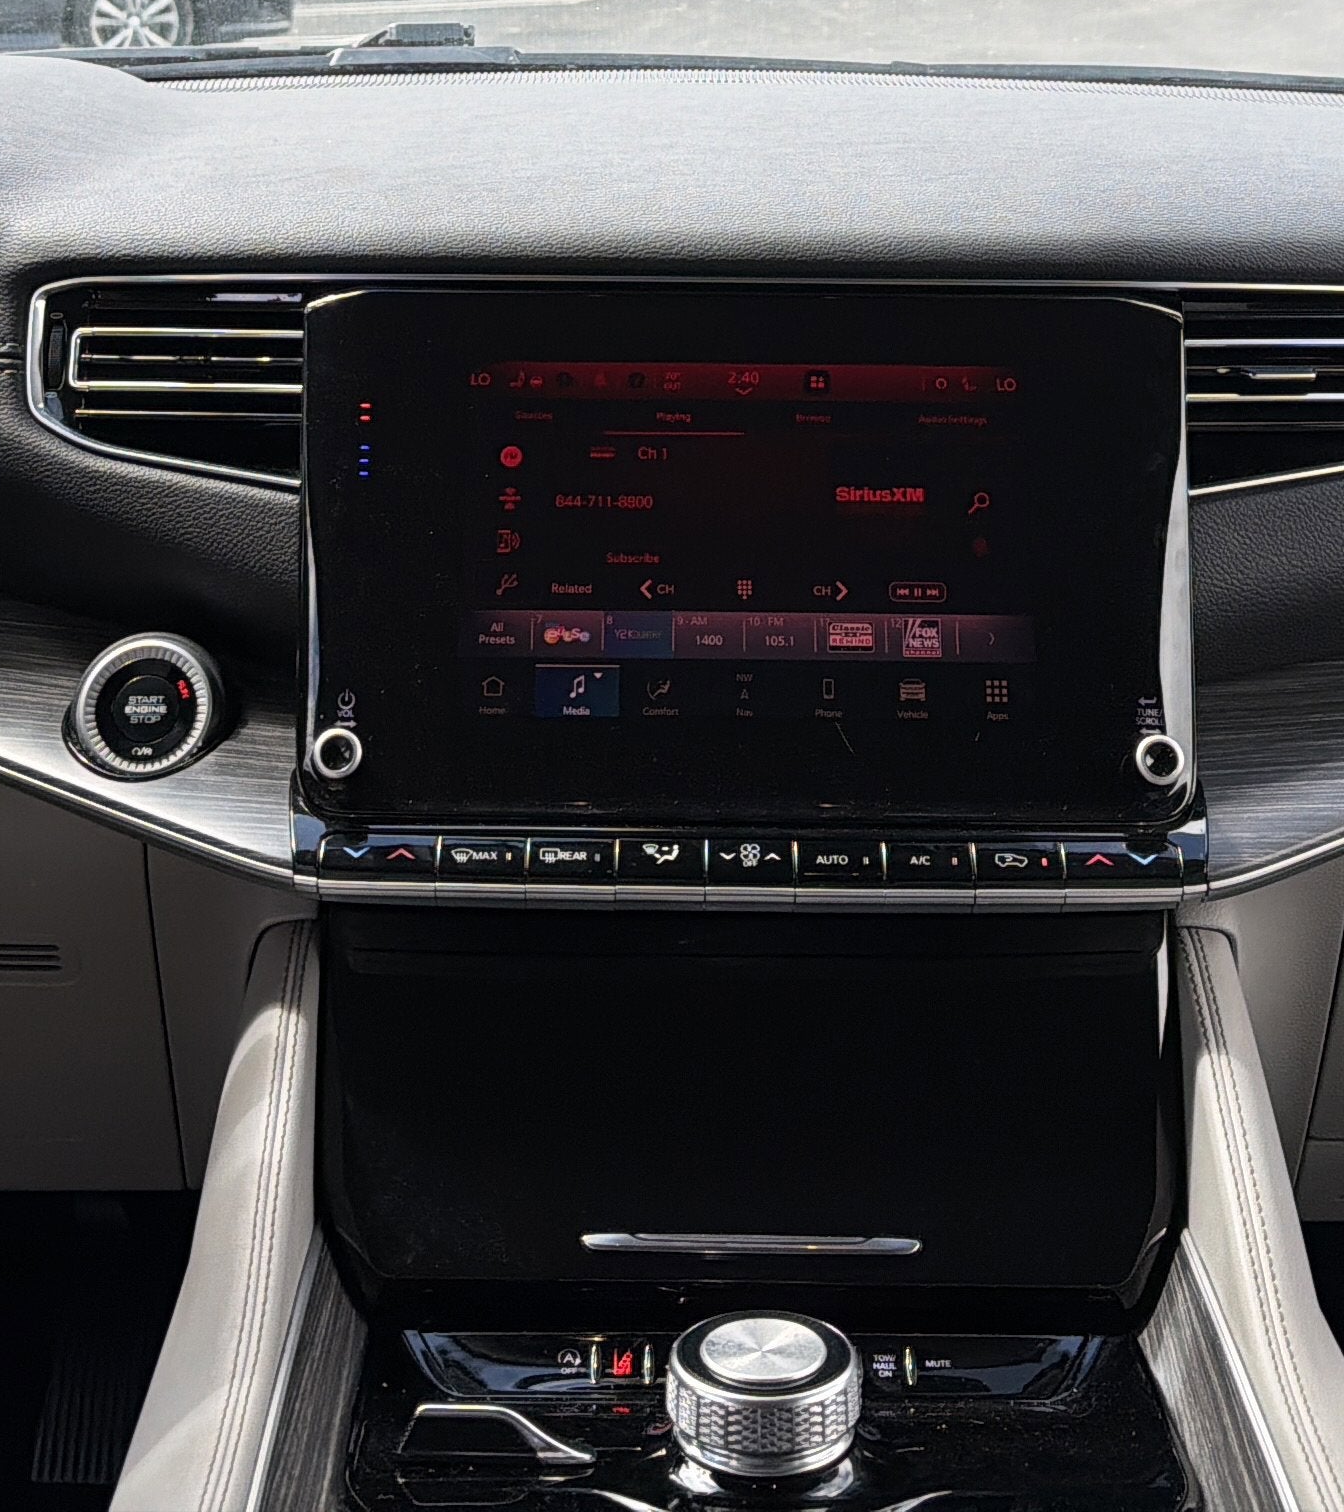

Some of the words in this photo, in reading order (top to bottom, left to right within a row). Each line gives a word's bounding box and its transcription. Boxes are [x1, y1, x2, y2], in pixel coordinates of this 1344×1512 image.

[470, 372, 493, 387] LO
[995, 378, 1019, 392] LO
[835, 486, 925, 503] SiriusXM
[606, 551, 661, 565] Subscribe
[551, 582, 593, 595] Related
[656, 584, 676, 595] CH
[812, 585, 832, 596] CH
[606, 615, 614, 625] 8
[490, 622, 505, 633] All
[916, 627, 939, 637] FOX
[479, 634, 516, 645] Presets
[695, 634, 724, 646] 1400
[764, 635, 795, 647] 105.1
[831, 637, 872, 646] REWIND
[908, 638, 940, 648] NEWS
[127, 695, 166, 704] START
[124, 705, 168, 713] ENGINE
[336, 709, 355, 718] VOL
[479, 706, 506, 716] Home
[562, 706, 591, 716] Media
[642, 707, 680, 716] Comfort
[736, 709, 753, 718] Nav
[815, 708, 843, 719] Phone
[1136, 708, 1163, 718] TUNE/
[129, 715, 162, 724] STOP
[896, 709, 929, 720] Vehicle
[986, 711, 1009, 722] Apps
[1135, 716, 1164, 726] SCROLL
[471, 850, 498, 861] MAX
[559, 850, 588, 862] REAR
[815, 854, 849, 866] AUTO
[909, 854, 932, 866] A/C
[742, 859, 758, 868] OFF
[872, 1362, 897, 1370] HAUL
[925, 1359, 952, 1368] MUTE
[560, 1367, 578, 1375] OFF
[878, 1370, 893, 1378] ON
